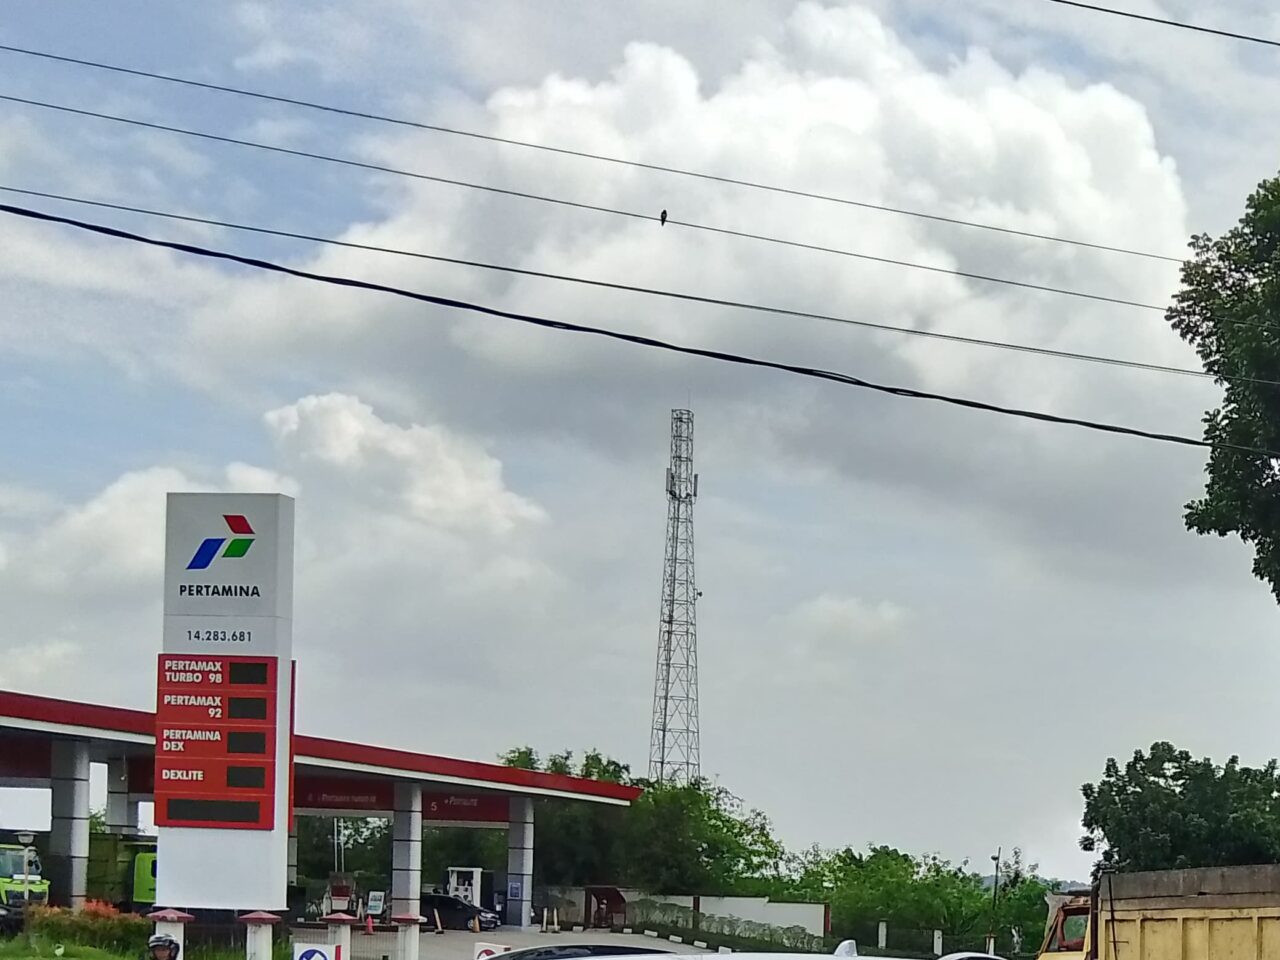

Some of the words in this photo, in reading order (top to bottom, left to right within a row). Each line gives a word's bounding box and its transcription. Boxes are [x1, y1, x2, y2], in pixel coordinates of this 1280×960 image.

[179, 584, 261, 598] PERTAMINA
[186, 629, 253, 643] 14.283.681
[164, 659, 222, 672] PERTAMAX
[164, 671, 203, 684] TURBO
[208, 672, 223, 684] 98
[163, 694, 222, 707] PERTAMAX
[208, 707, 222, 719] 92
[163, 728, 222, 742] PERTAMINA
[162, 739, 185, 752] DEX
[161, 768, 204, 782] DEXLITE
